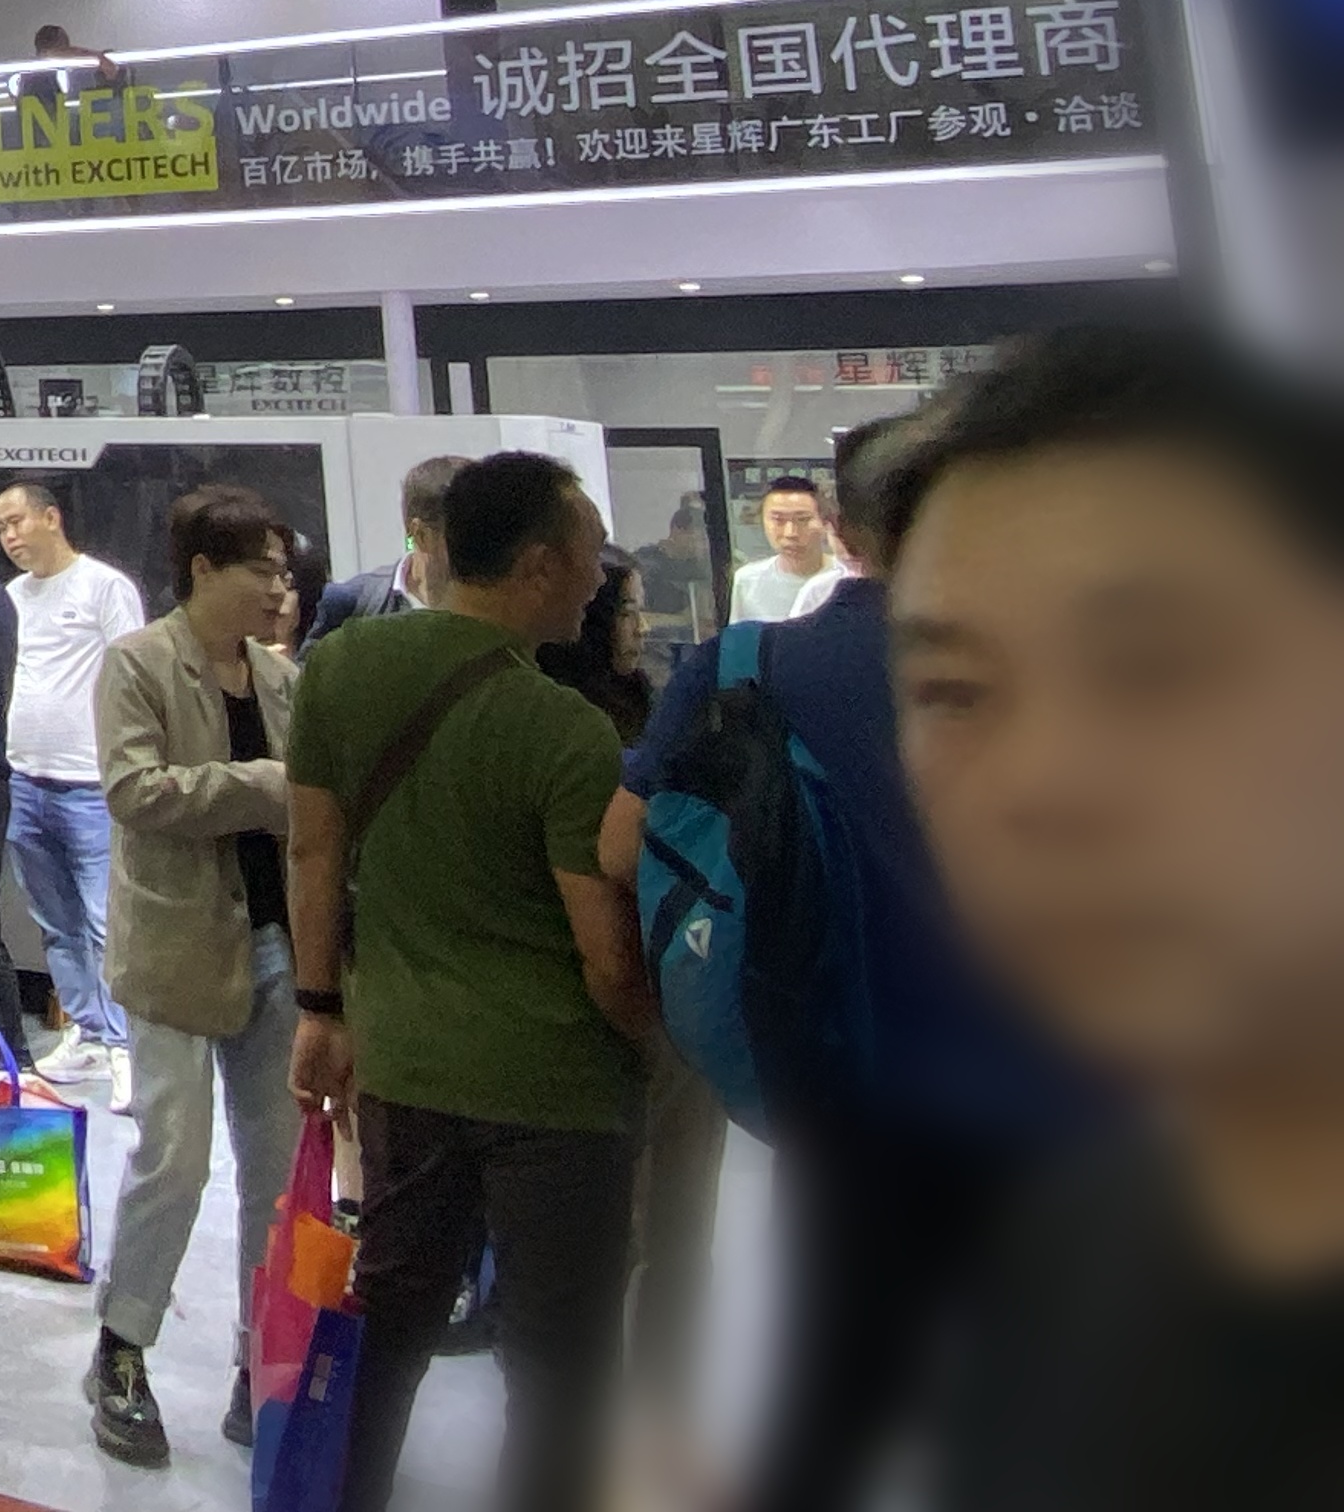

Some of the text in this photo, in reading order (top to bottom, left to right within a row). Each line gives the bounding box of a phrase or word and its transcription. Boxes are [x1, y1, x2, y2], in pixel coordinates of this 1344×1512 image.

[235, 89, 452, 136] Worldwide
[0, 162, 61, 188] with
[70, 151, 211, 185] EXCITECH
